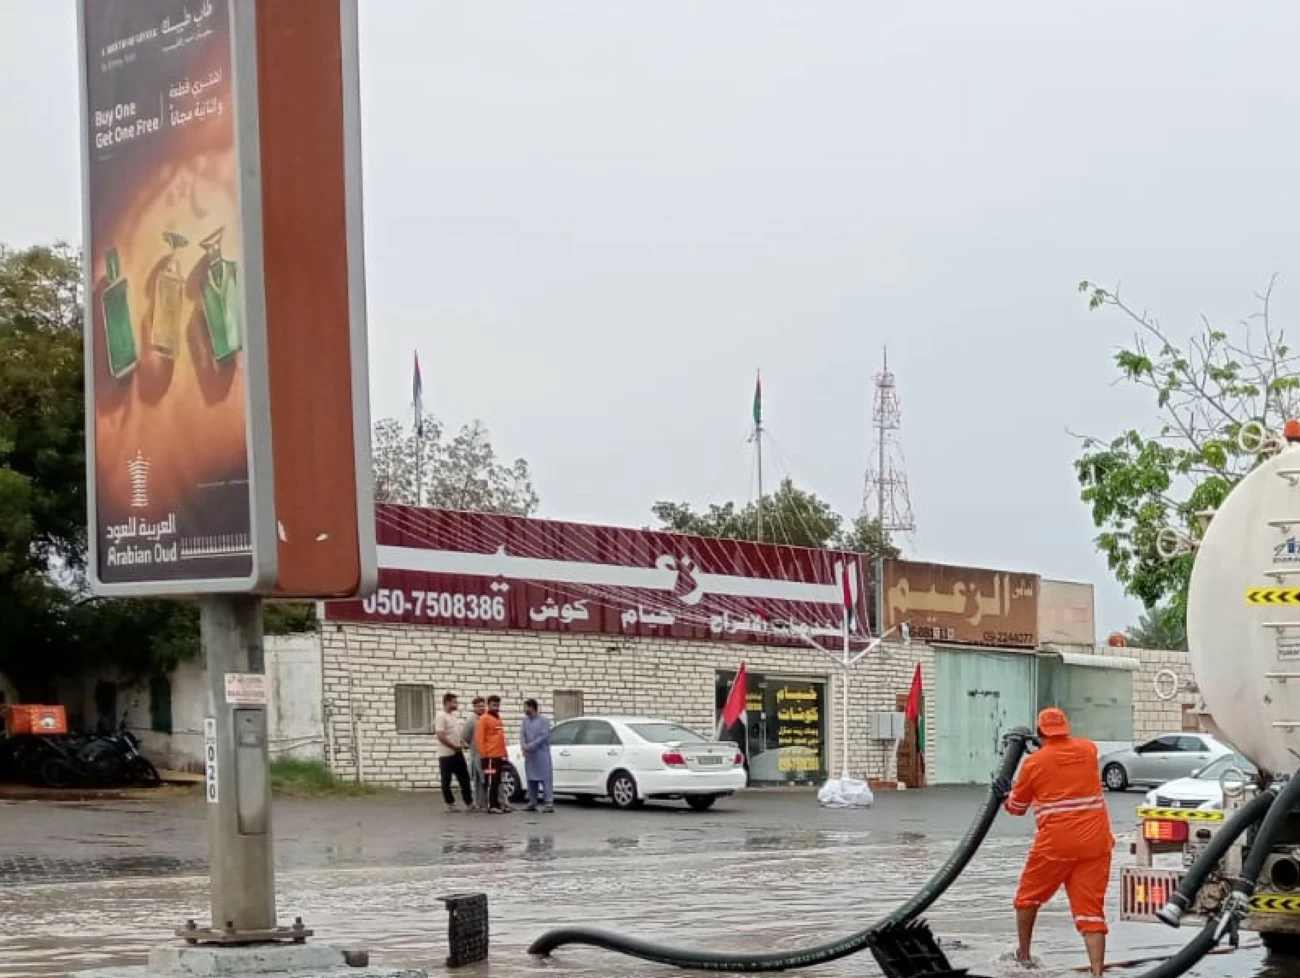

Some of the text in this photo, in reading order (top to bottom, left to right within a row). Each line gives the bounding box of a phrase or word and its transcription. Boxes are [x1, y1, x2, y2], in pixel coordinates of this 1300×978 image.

[95, 102, 136, 128] Buy One
[95, 116, 159, 149] Get One Free
[105, 512, 177, 544] العربية للعود
[106, 541, 178, 566] Arabian Oud
[529, 597, 591, 624] كوش
[888, 572, 1011, 627] الزعيم
